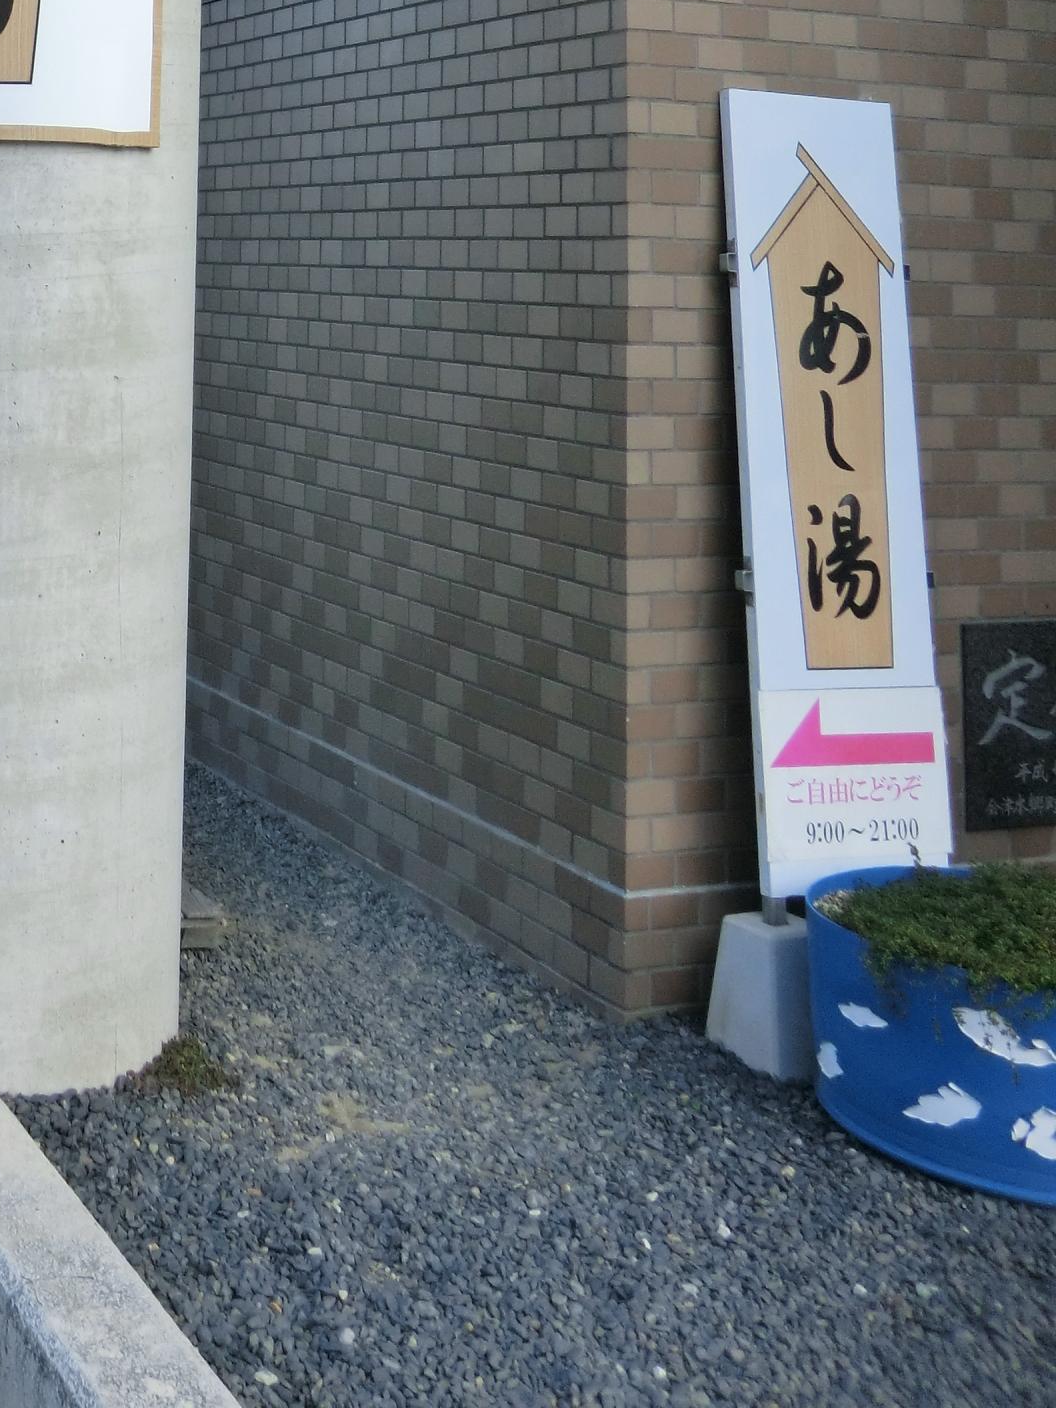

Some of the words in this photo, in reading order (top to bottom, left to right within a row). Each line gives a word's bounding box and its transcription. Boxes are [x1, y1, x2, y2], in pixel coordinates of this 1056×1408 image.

[798, 260, 881, 621] あし湯
[978, 648, 1056, 745] 定
[786, 775, 922, 805] ご自由にどうぞ
